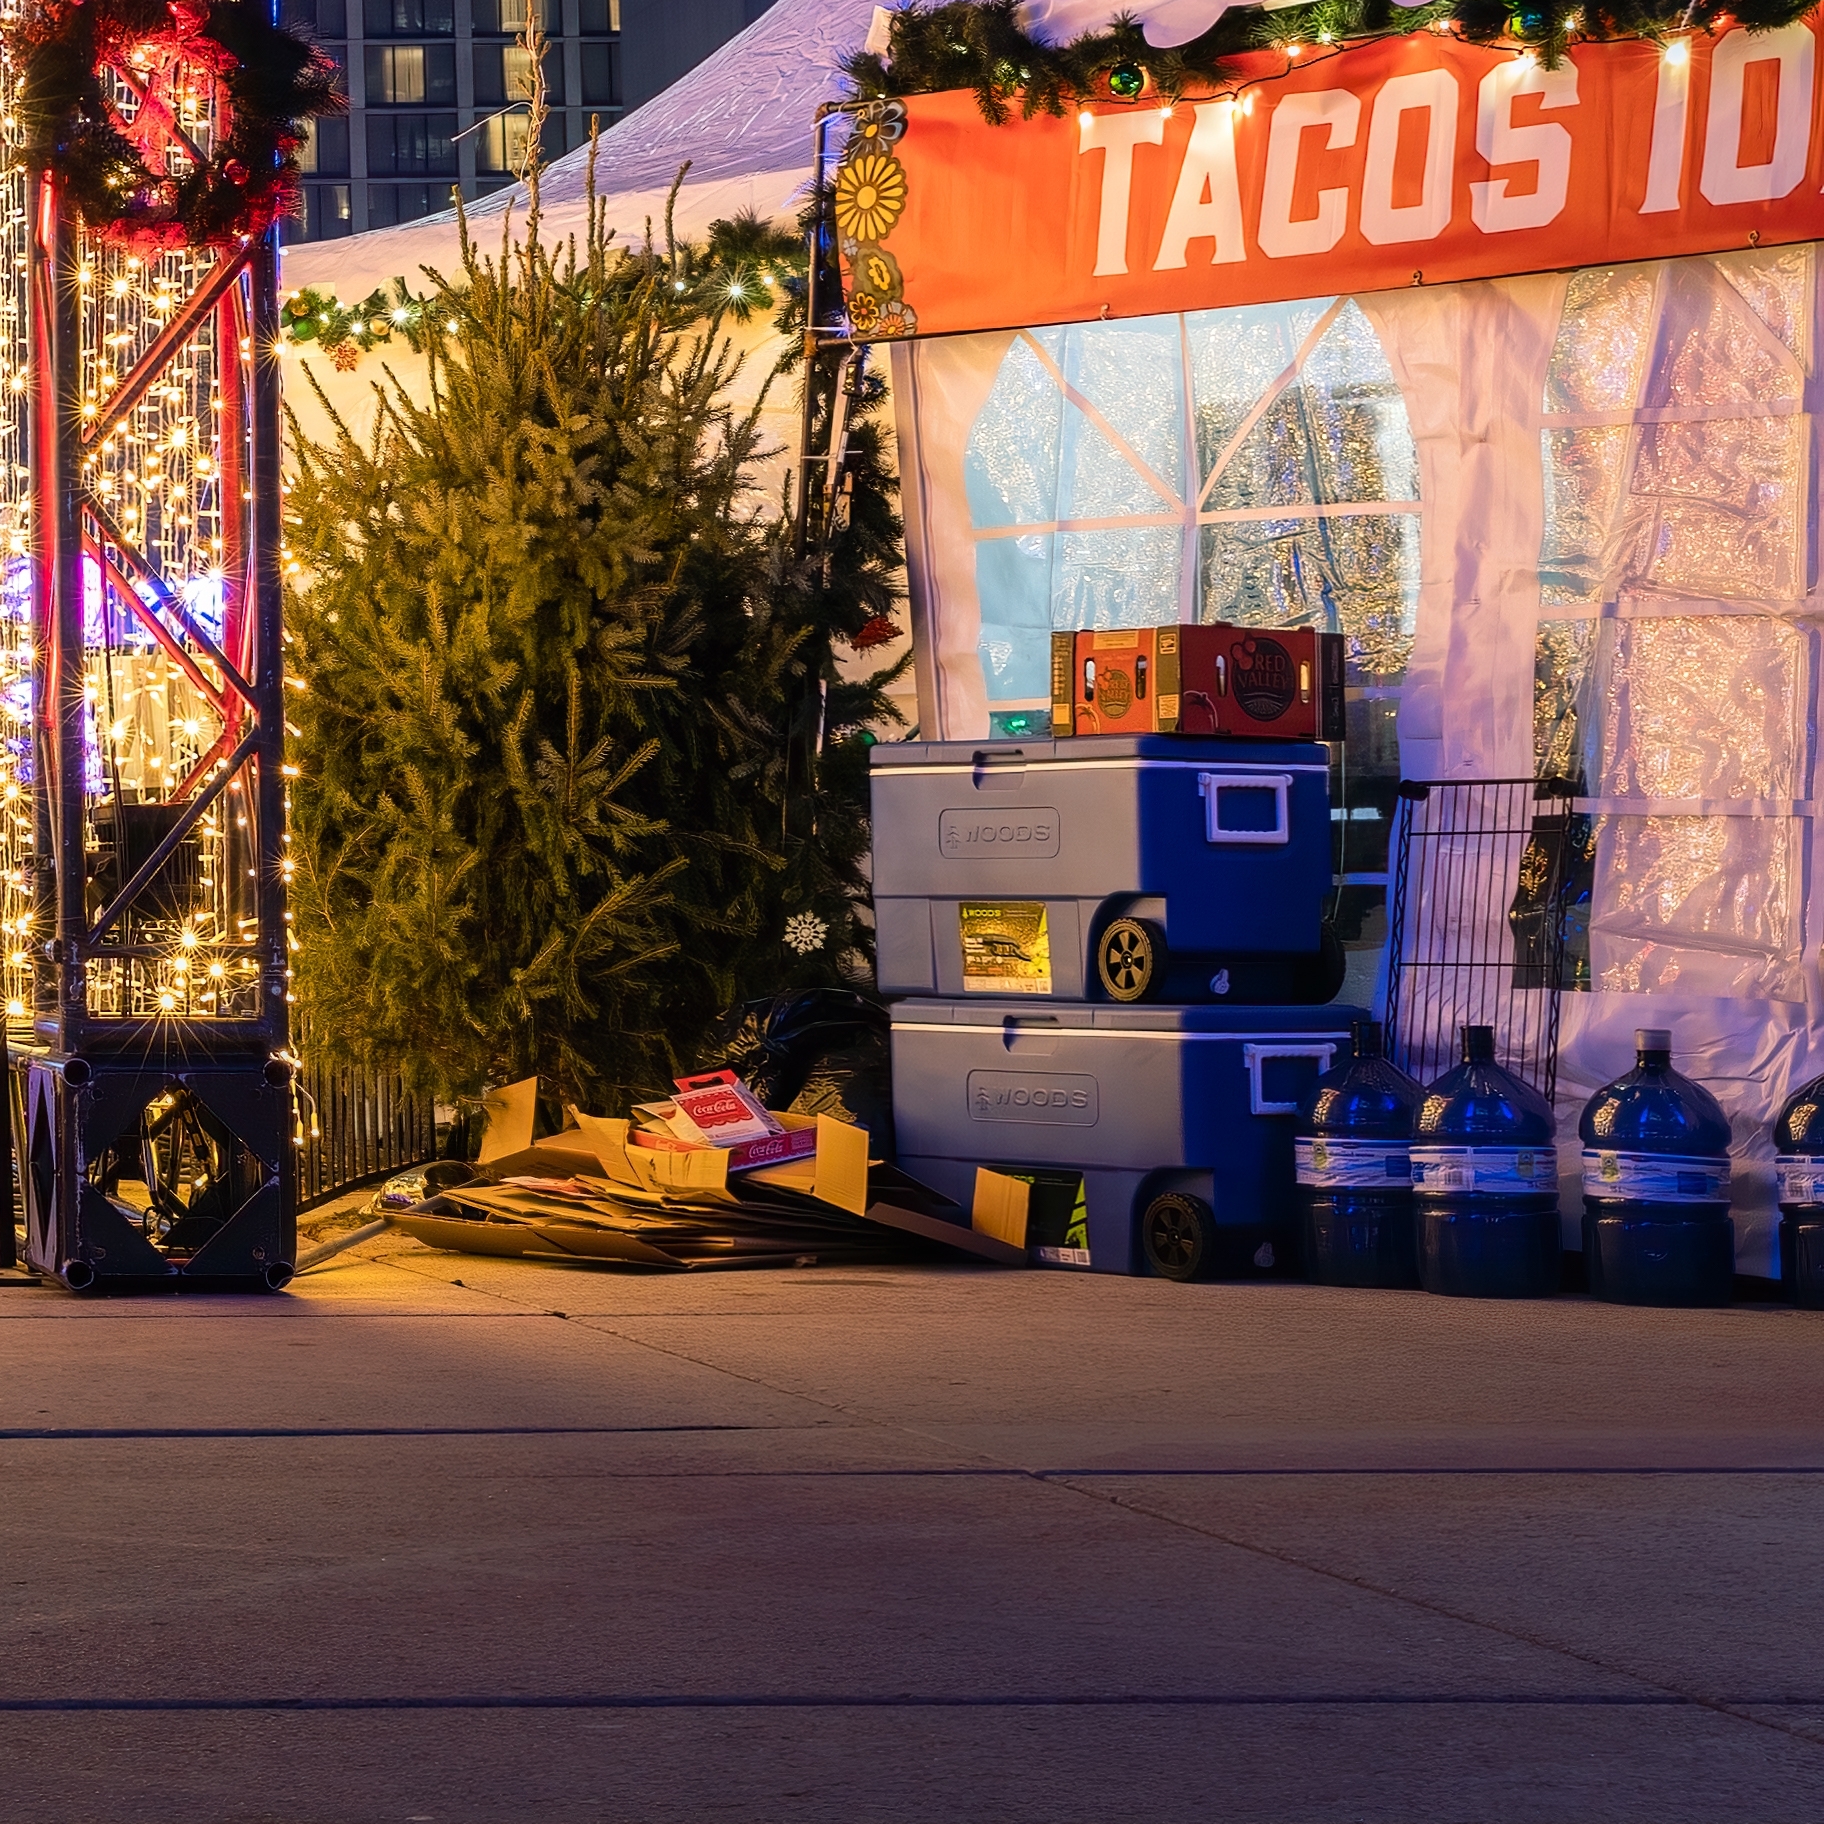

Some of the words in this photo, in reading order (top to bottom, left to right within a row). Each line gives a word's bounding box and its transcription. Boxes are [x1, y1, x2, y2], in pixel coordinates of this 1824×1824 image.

[1079, 55, 1581, 277] TACOS
[1639, 22, 1824, 214] 10
[1255, 654, 1286, 672] RED
[1237, 671, 1288, 690] VALLEY
[966, 825, 1051, 843] WOODS
[996, 1087, 1089, 1108] WOODS
